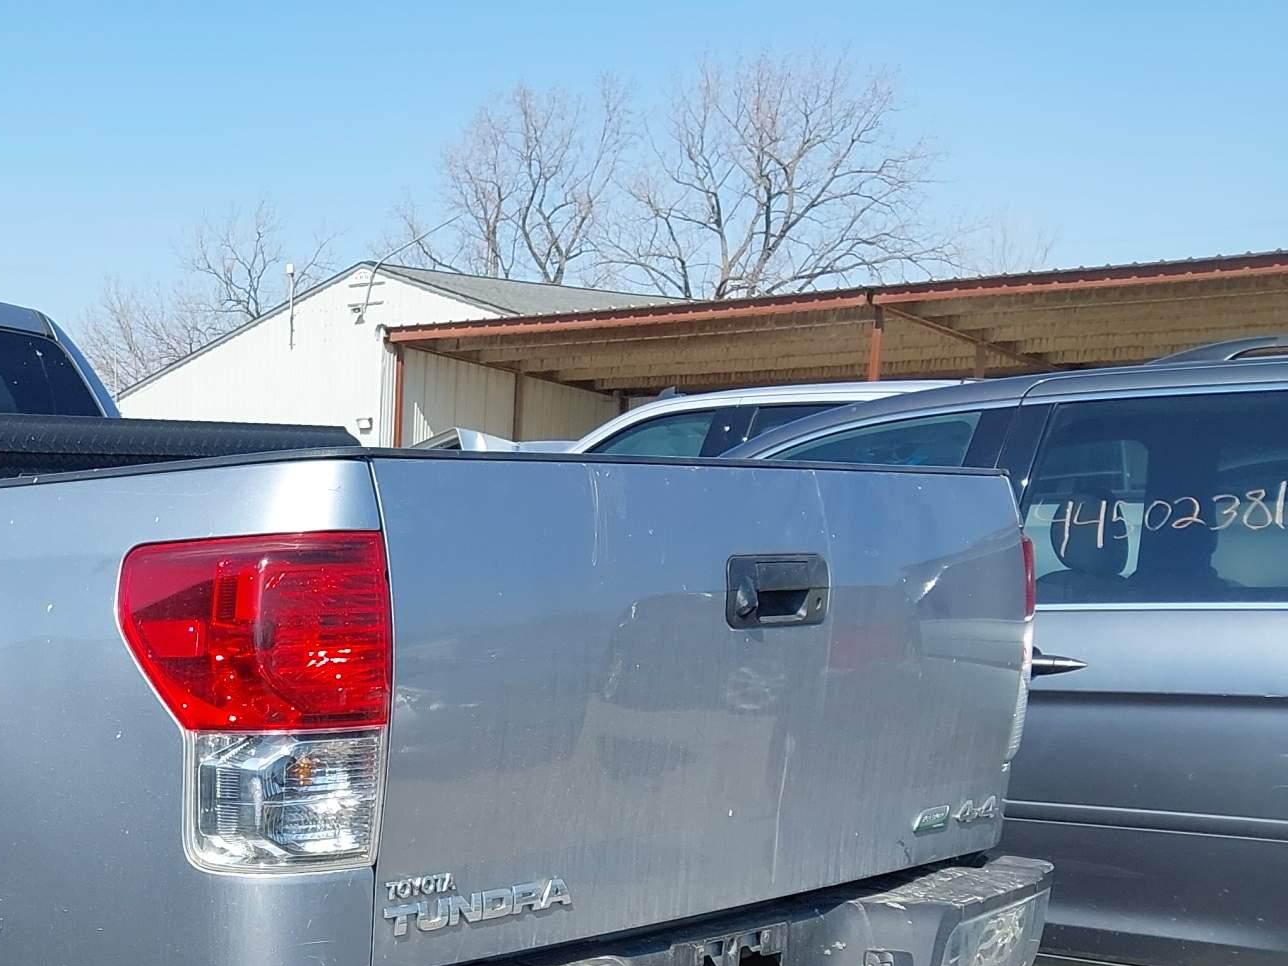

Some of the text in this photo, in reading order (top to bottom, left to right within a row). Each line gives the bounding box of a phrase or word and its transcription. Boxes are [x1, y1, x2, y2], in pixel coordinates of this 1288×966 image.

[1034, 480, 1287, 558] 44502381
[383, 878, 572, 937] TUNDRA
[385, 872, 456, 900] TOYOTA
